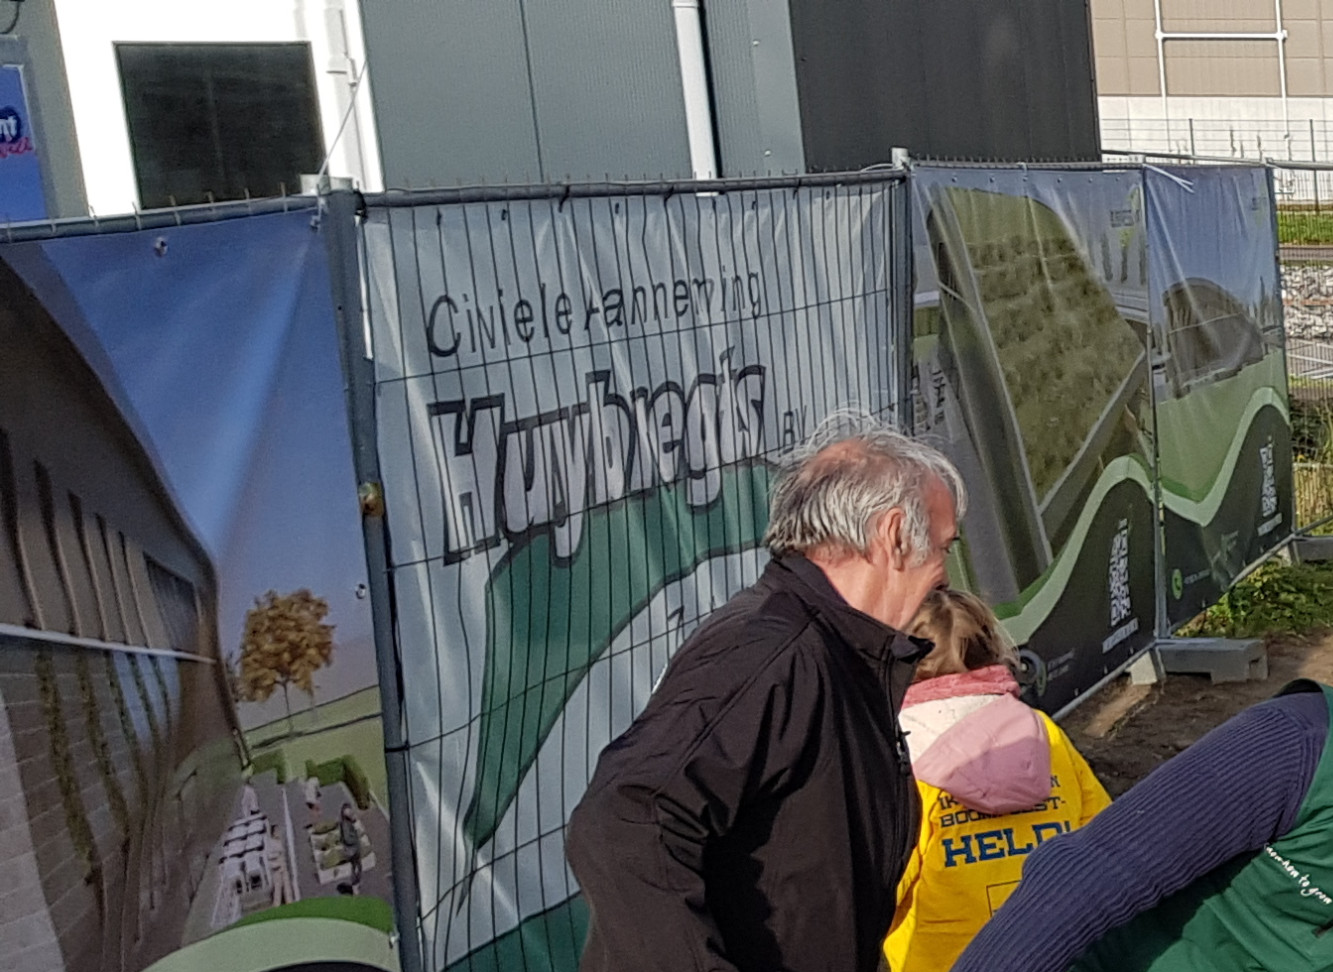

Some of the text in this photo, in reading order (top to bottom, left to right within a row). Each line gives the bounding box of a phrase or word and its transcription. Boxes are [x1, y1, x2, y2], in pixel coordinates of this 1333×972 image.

[427, 265, 760, 357] Civiele Aanneming
[427, 346, 766, 567] Huybregts
[1298, 873, 1311, 887] to
[1300, 887, 1333, 905] grow
